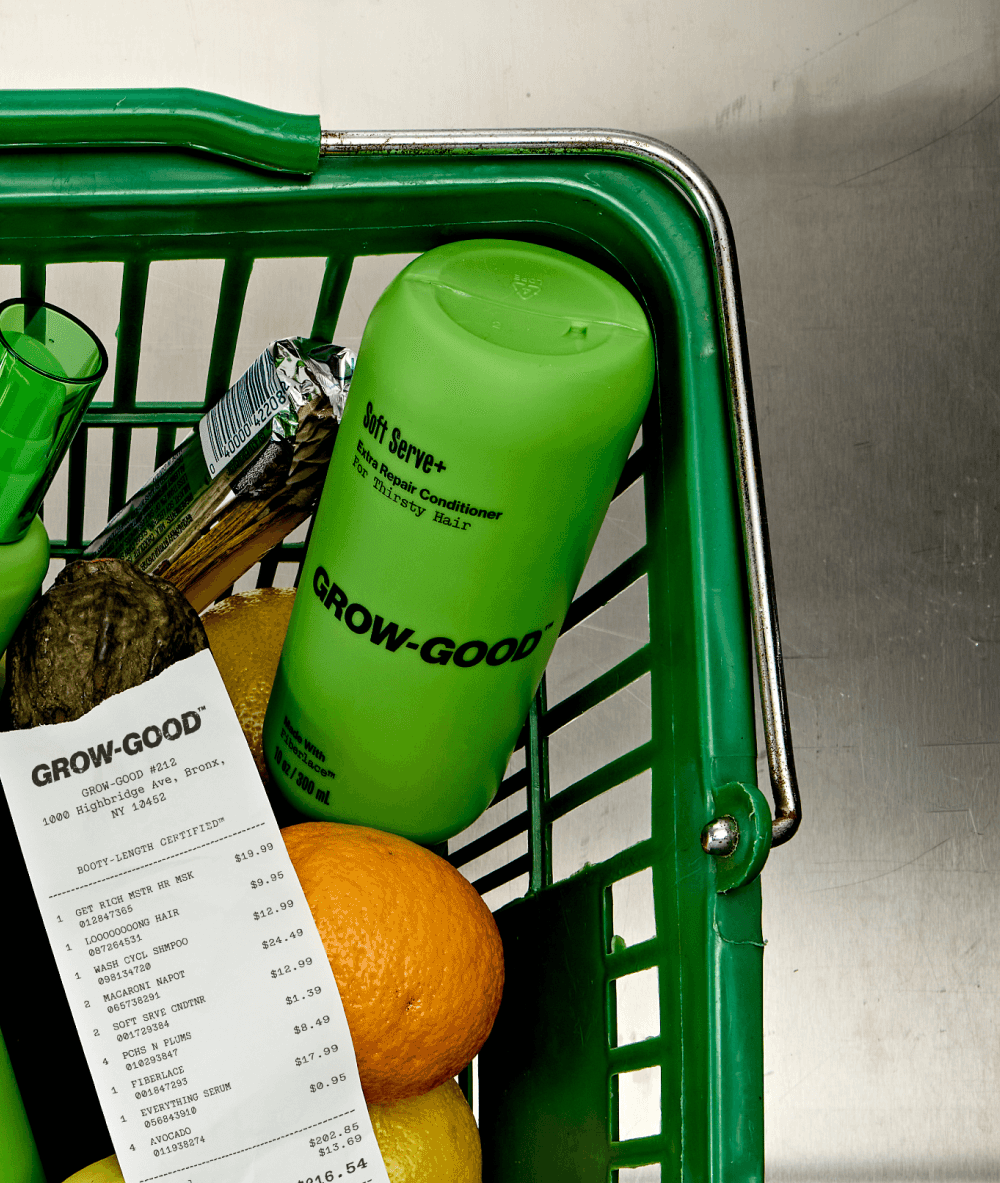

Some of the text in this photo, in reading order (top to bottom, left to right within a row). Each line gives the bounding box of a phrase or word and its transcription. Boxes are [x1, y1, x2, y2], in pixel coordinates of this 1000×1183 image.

[223, 423, 252, 456] 40000
[254, 390, 286, 425] 42208
[362, 400, 447, 474] Soft Serve+
[352, 454, 471, 531] For Thirsty Hair
[356, 438, 503, 520] Extra Repair Conditioner
[42, 758, 225, 827] 1000 Highbridge Ave, Bronx,
[81, 757, 178, 798] GROW-GOOD #212
[110, 792, 167, 819] NY 10452
[75, 842, 274, 917] GET RICH MSTR HR MSK $19.99
[76, 842, 155, 875] BOOTY-LENGTH
[154, 908, 180, 923] HAIR
[249, 870, 285, 890] $9.95
[93, 899, 294, 974] WASH CYCL SHMPOO $12.99
[102, 928, 304, 1003] MACARONI NAPOT $24.49
[112, 956, 313, 1031] SOFT SRVE CNDTNR $12.99
[121, 985, 322, 1060] PCHS PLUMS $1.39
[130, 1014, 331, 1089] FIBERLACE $8.49
[139, 1043, 339, 1117] EVERYTHING SERUM $17.99
[150, 1072, 347, 1146] AVOCADO $0.95
[308, 1121, 360, 1148] $202.85
[318, 1133, 363, 1158] $13.69
